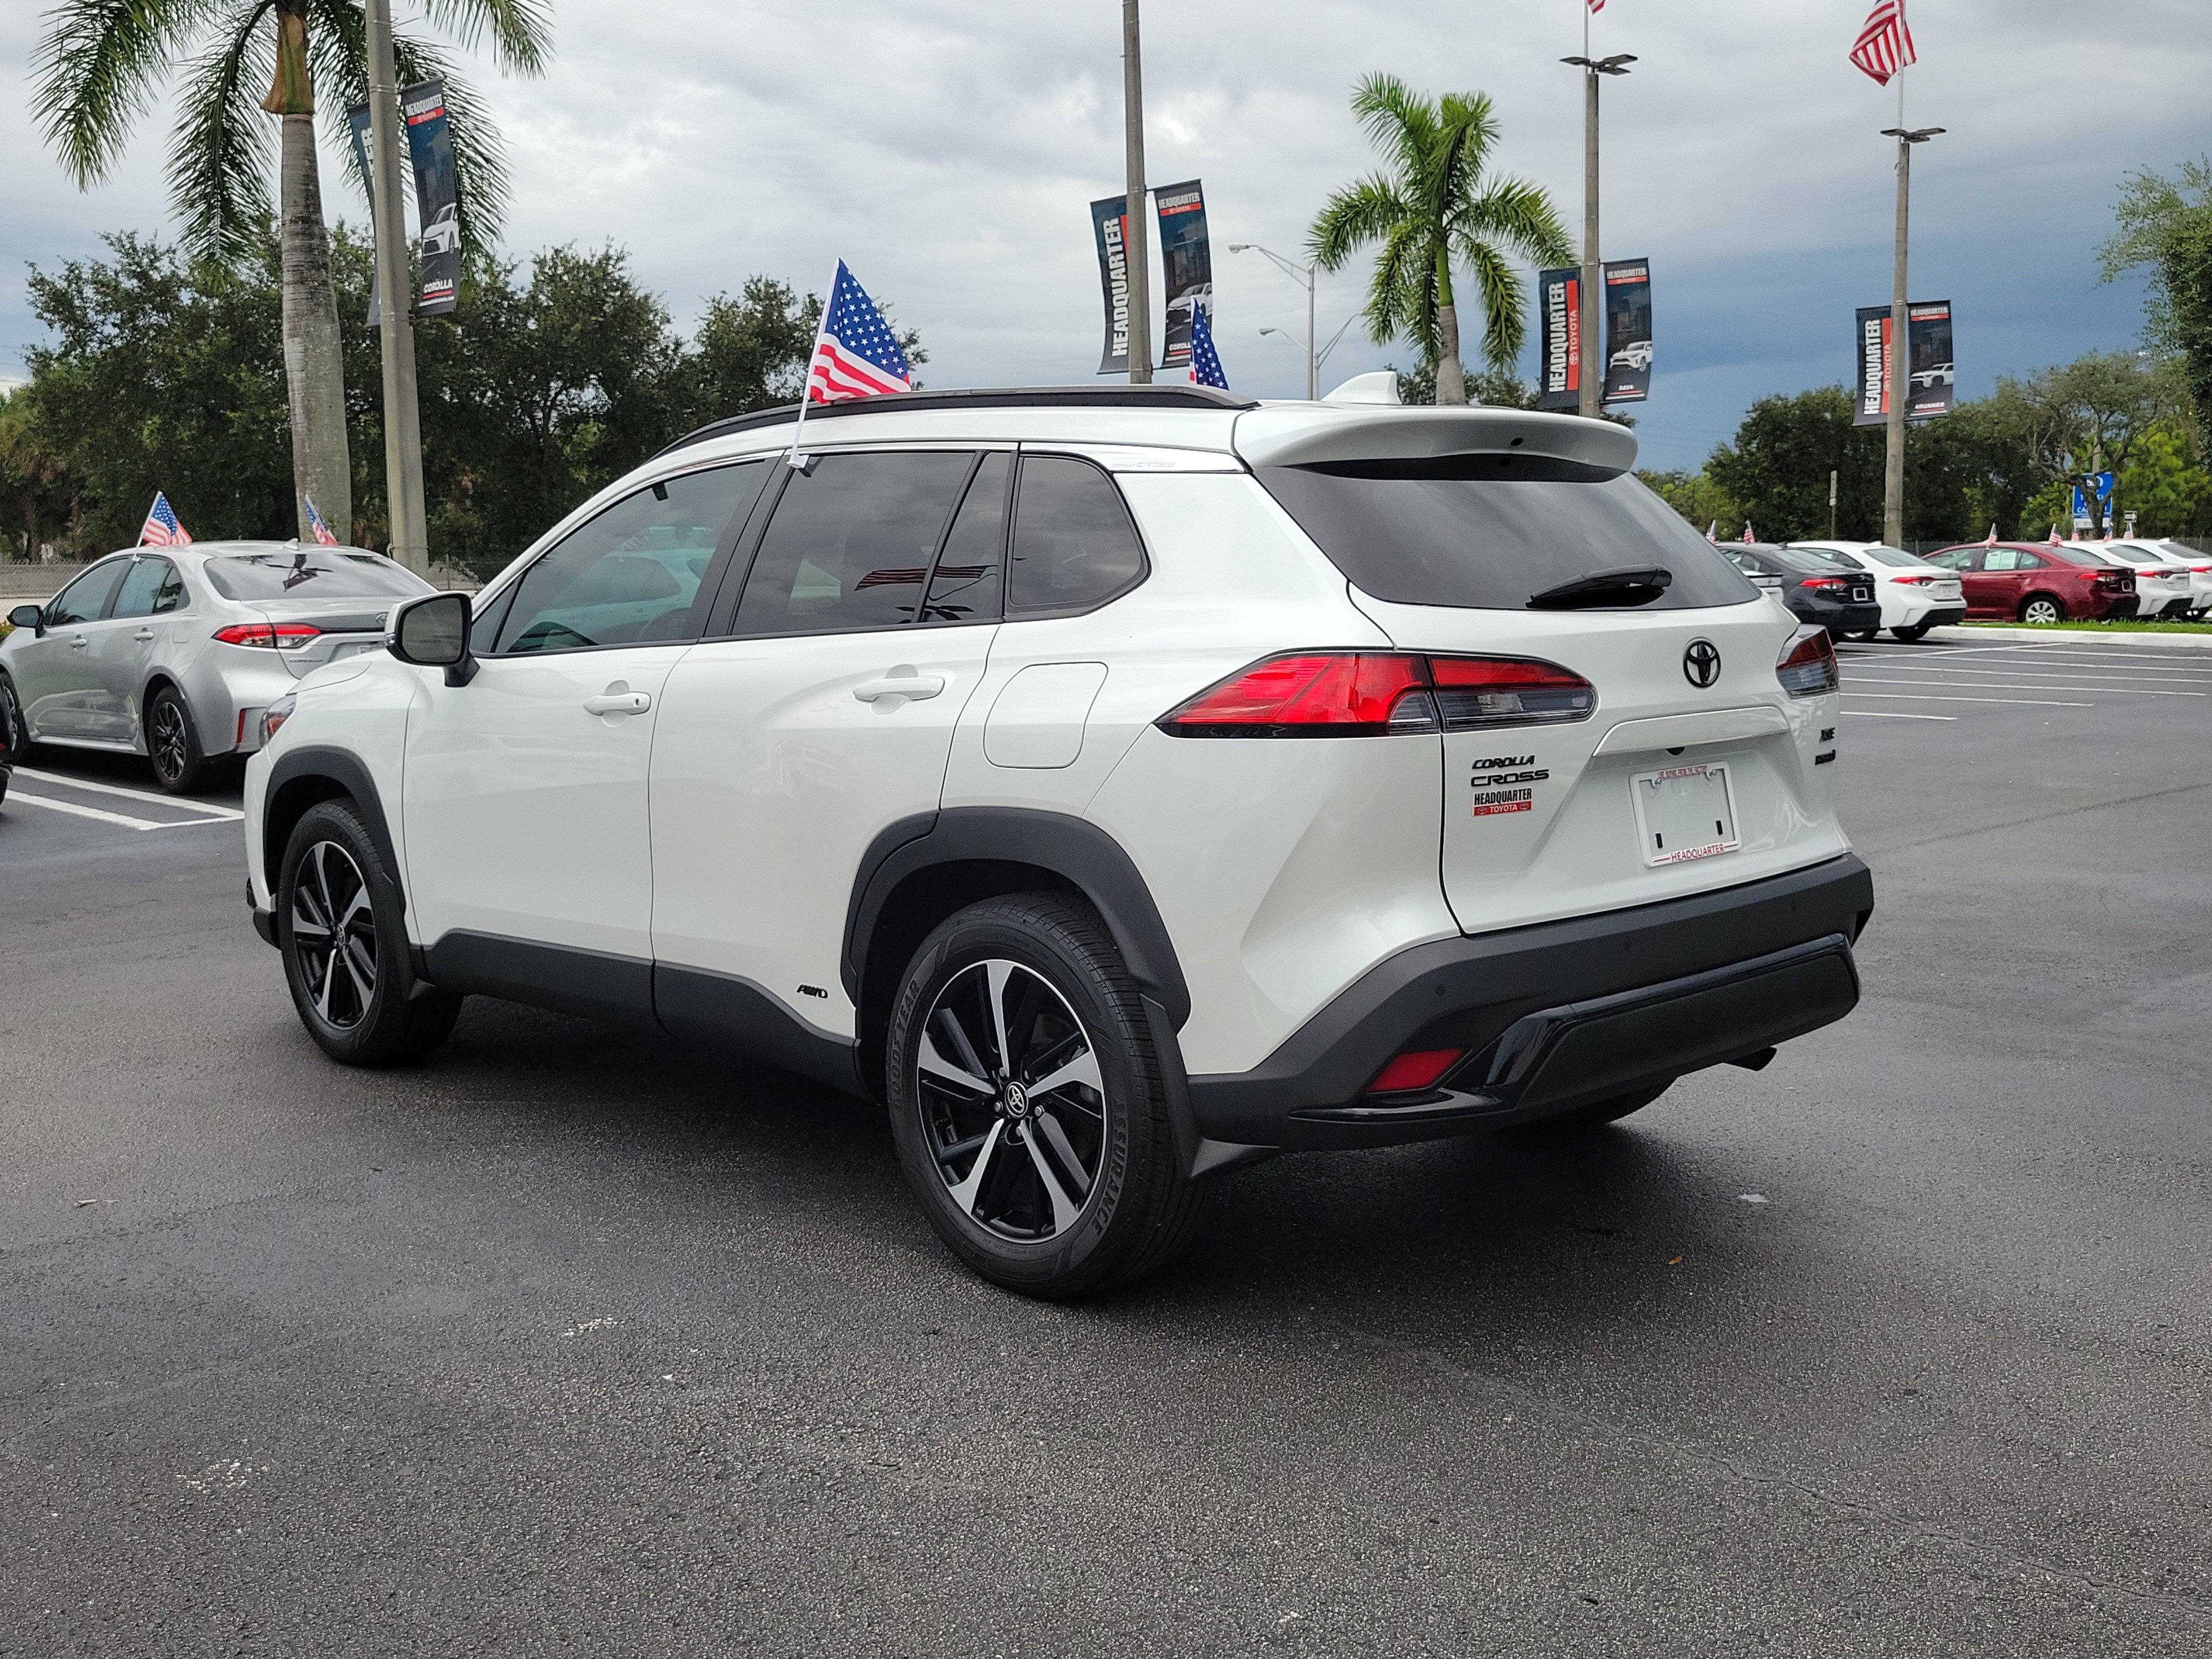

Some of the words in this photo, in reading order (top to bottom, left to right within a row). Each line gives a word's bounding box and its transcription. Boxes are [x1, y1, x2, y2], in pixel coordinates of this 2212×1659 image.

[1104, 218, 1130, 357] HEADQUARTER
[1549, 282, 1568, 393] HEADQUARTER
[1570, 309, 1578, 352] TOYOTA
[1169, 342, 1190, 351] COROLL
[1864, 319, 1882, 415] HEADQUARTER
[1472, 755, 1535, 769] COROLLA
[1471, 769, 1549, 787] CROSS
[1474, 788, 1532, 805] HEADQUARTER
[1489, 804, 1518, 814] TOYOTA
[1671, 844, 1724, 862] HEADQUARTER
